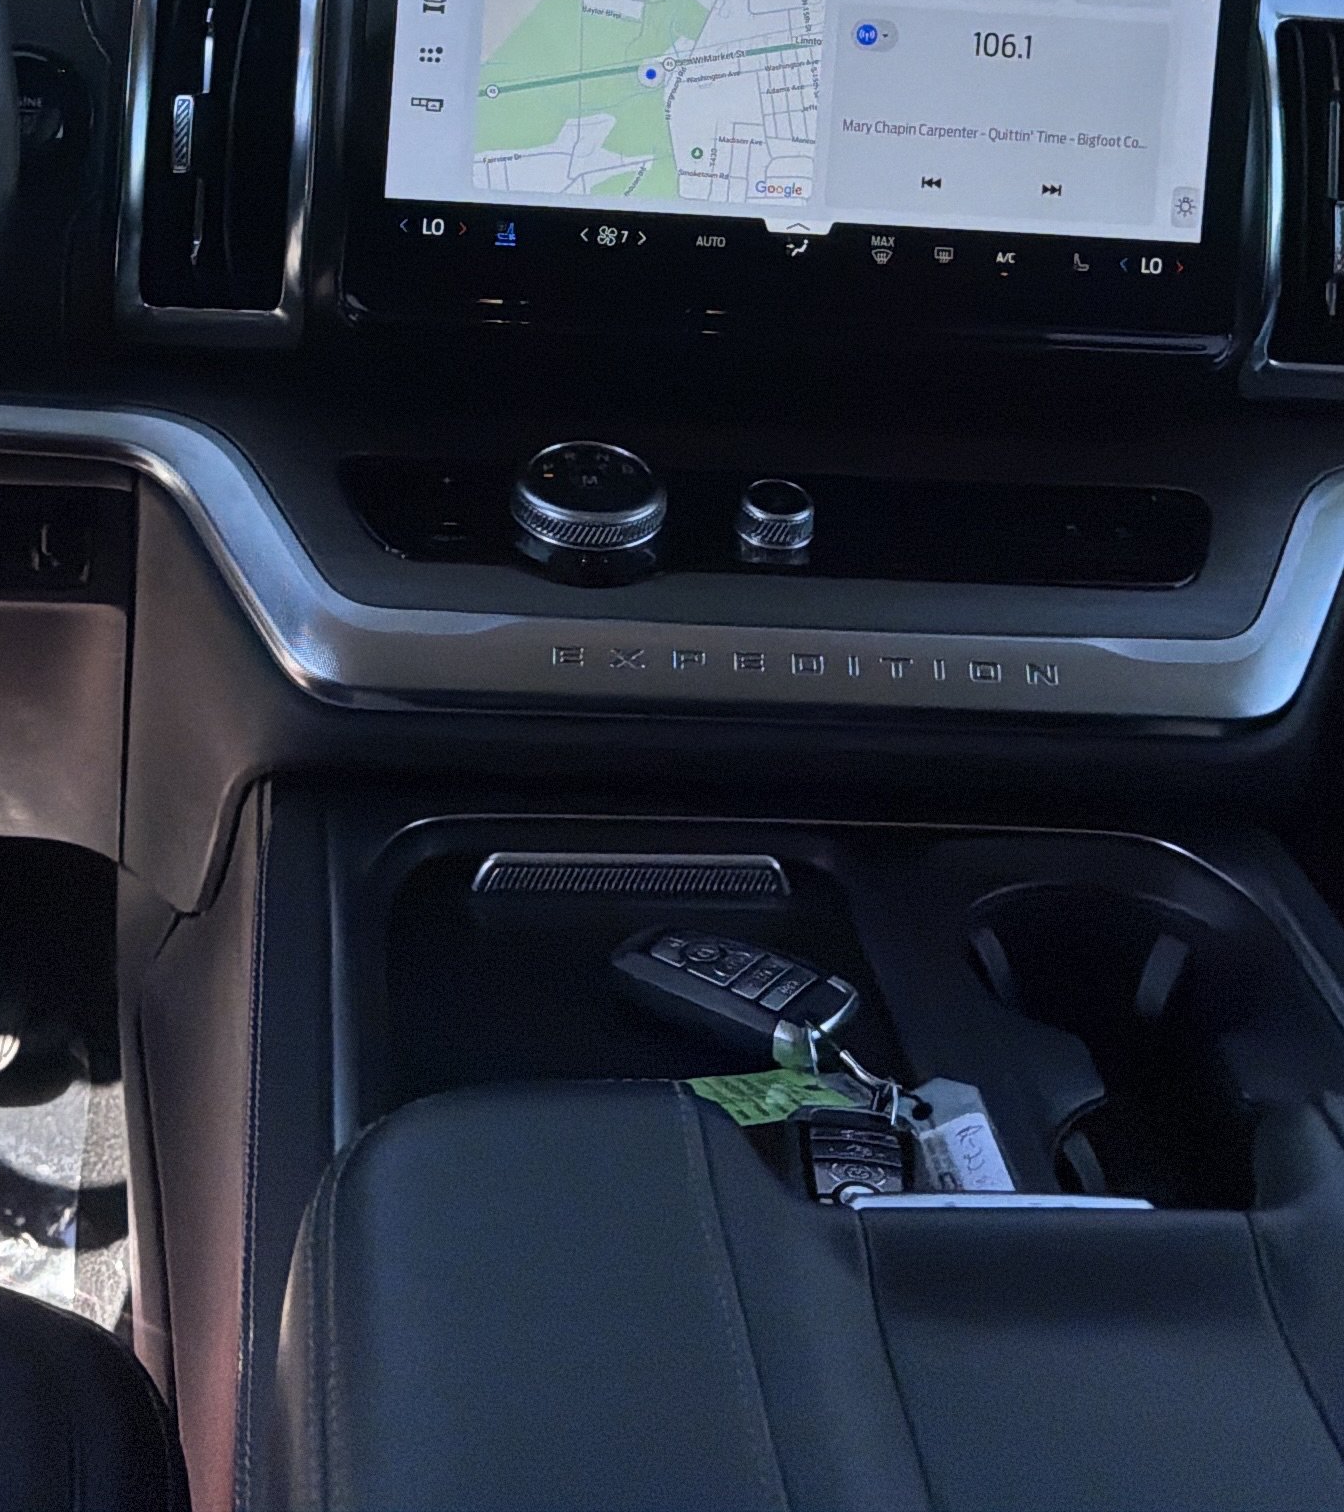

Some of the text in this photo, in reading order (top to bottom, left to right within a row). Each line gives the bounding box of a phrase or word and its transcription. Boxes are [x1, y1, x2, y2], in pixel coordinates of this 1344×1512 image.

[973, 31, 1033, 60] 106.1
[703, 52, 734, 64] Market
[843, 118, 872, 135] Mary
[874, 120, 917, 138] Chapin
[919, 123, 978, 140] Carpenter
[988, 127, 1034, 143] Quittin'
[1037, 130, 1067, 145] Time
[1077, 132, 1121, 149] Bigfoot
[756, 180, 802, 198] Google
[422, 217, 445, 236] LO
[620, 230, 629, 243] 7
[695, 235, 726, 248] AUTO
[871, 235, 895, 248] MAX
[996, 251, 1016, 264] A/C
[1141, 256, 1162, 274] LO
[551, 645, 1059, 687] EXPEDITION
